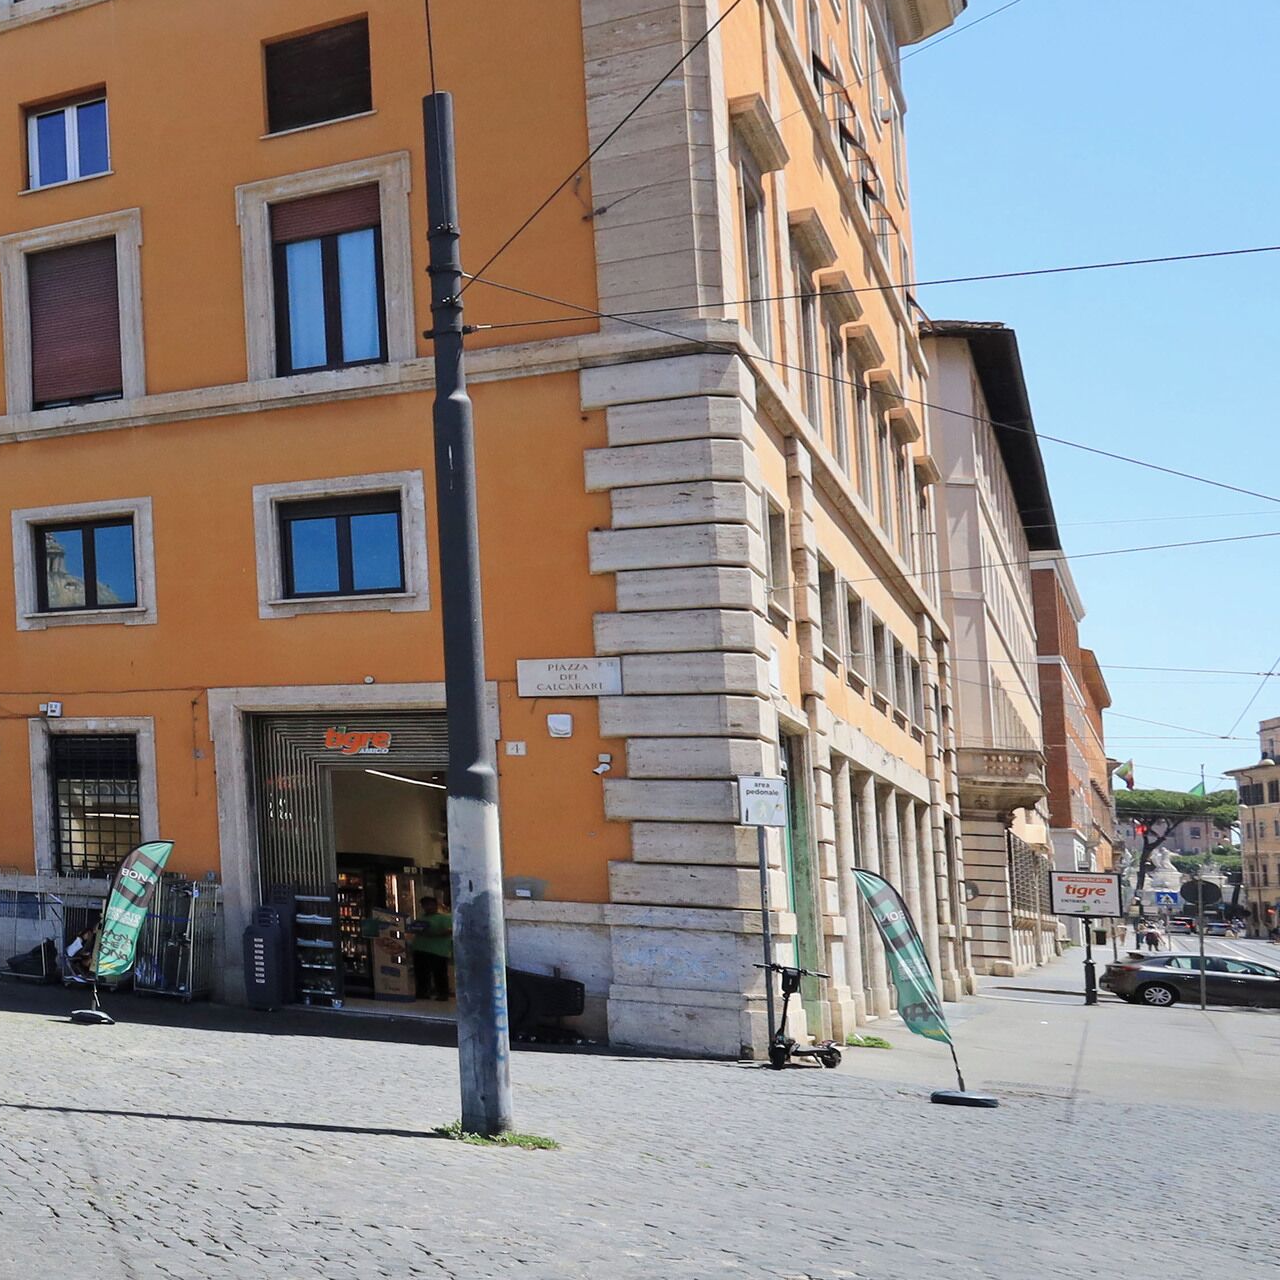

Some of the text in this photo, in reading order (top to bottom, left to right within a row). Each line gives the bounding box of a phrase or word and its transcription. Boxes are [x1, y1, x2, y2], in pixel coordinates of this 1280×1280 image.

[547, 663, 588, 672] PIAZZA
[536, 683, 603, 691] CALCARARI
[325, 727, 392, 755] tigre
[511, 744, 520, 754] 4
[121, 867, 155, 885] BONA
[1065, 885, 1107, 898] tigre
